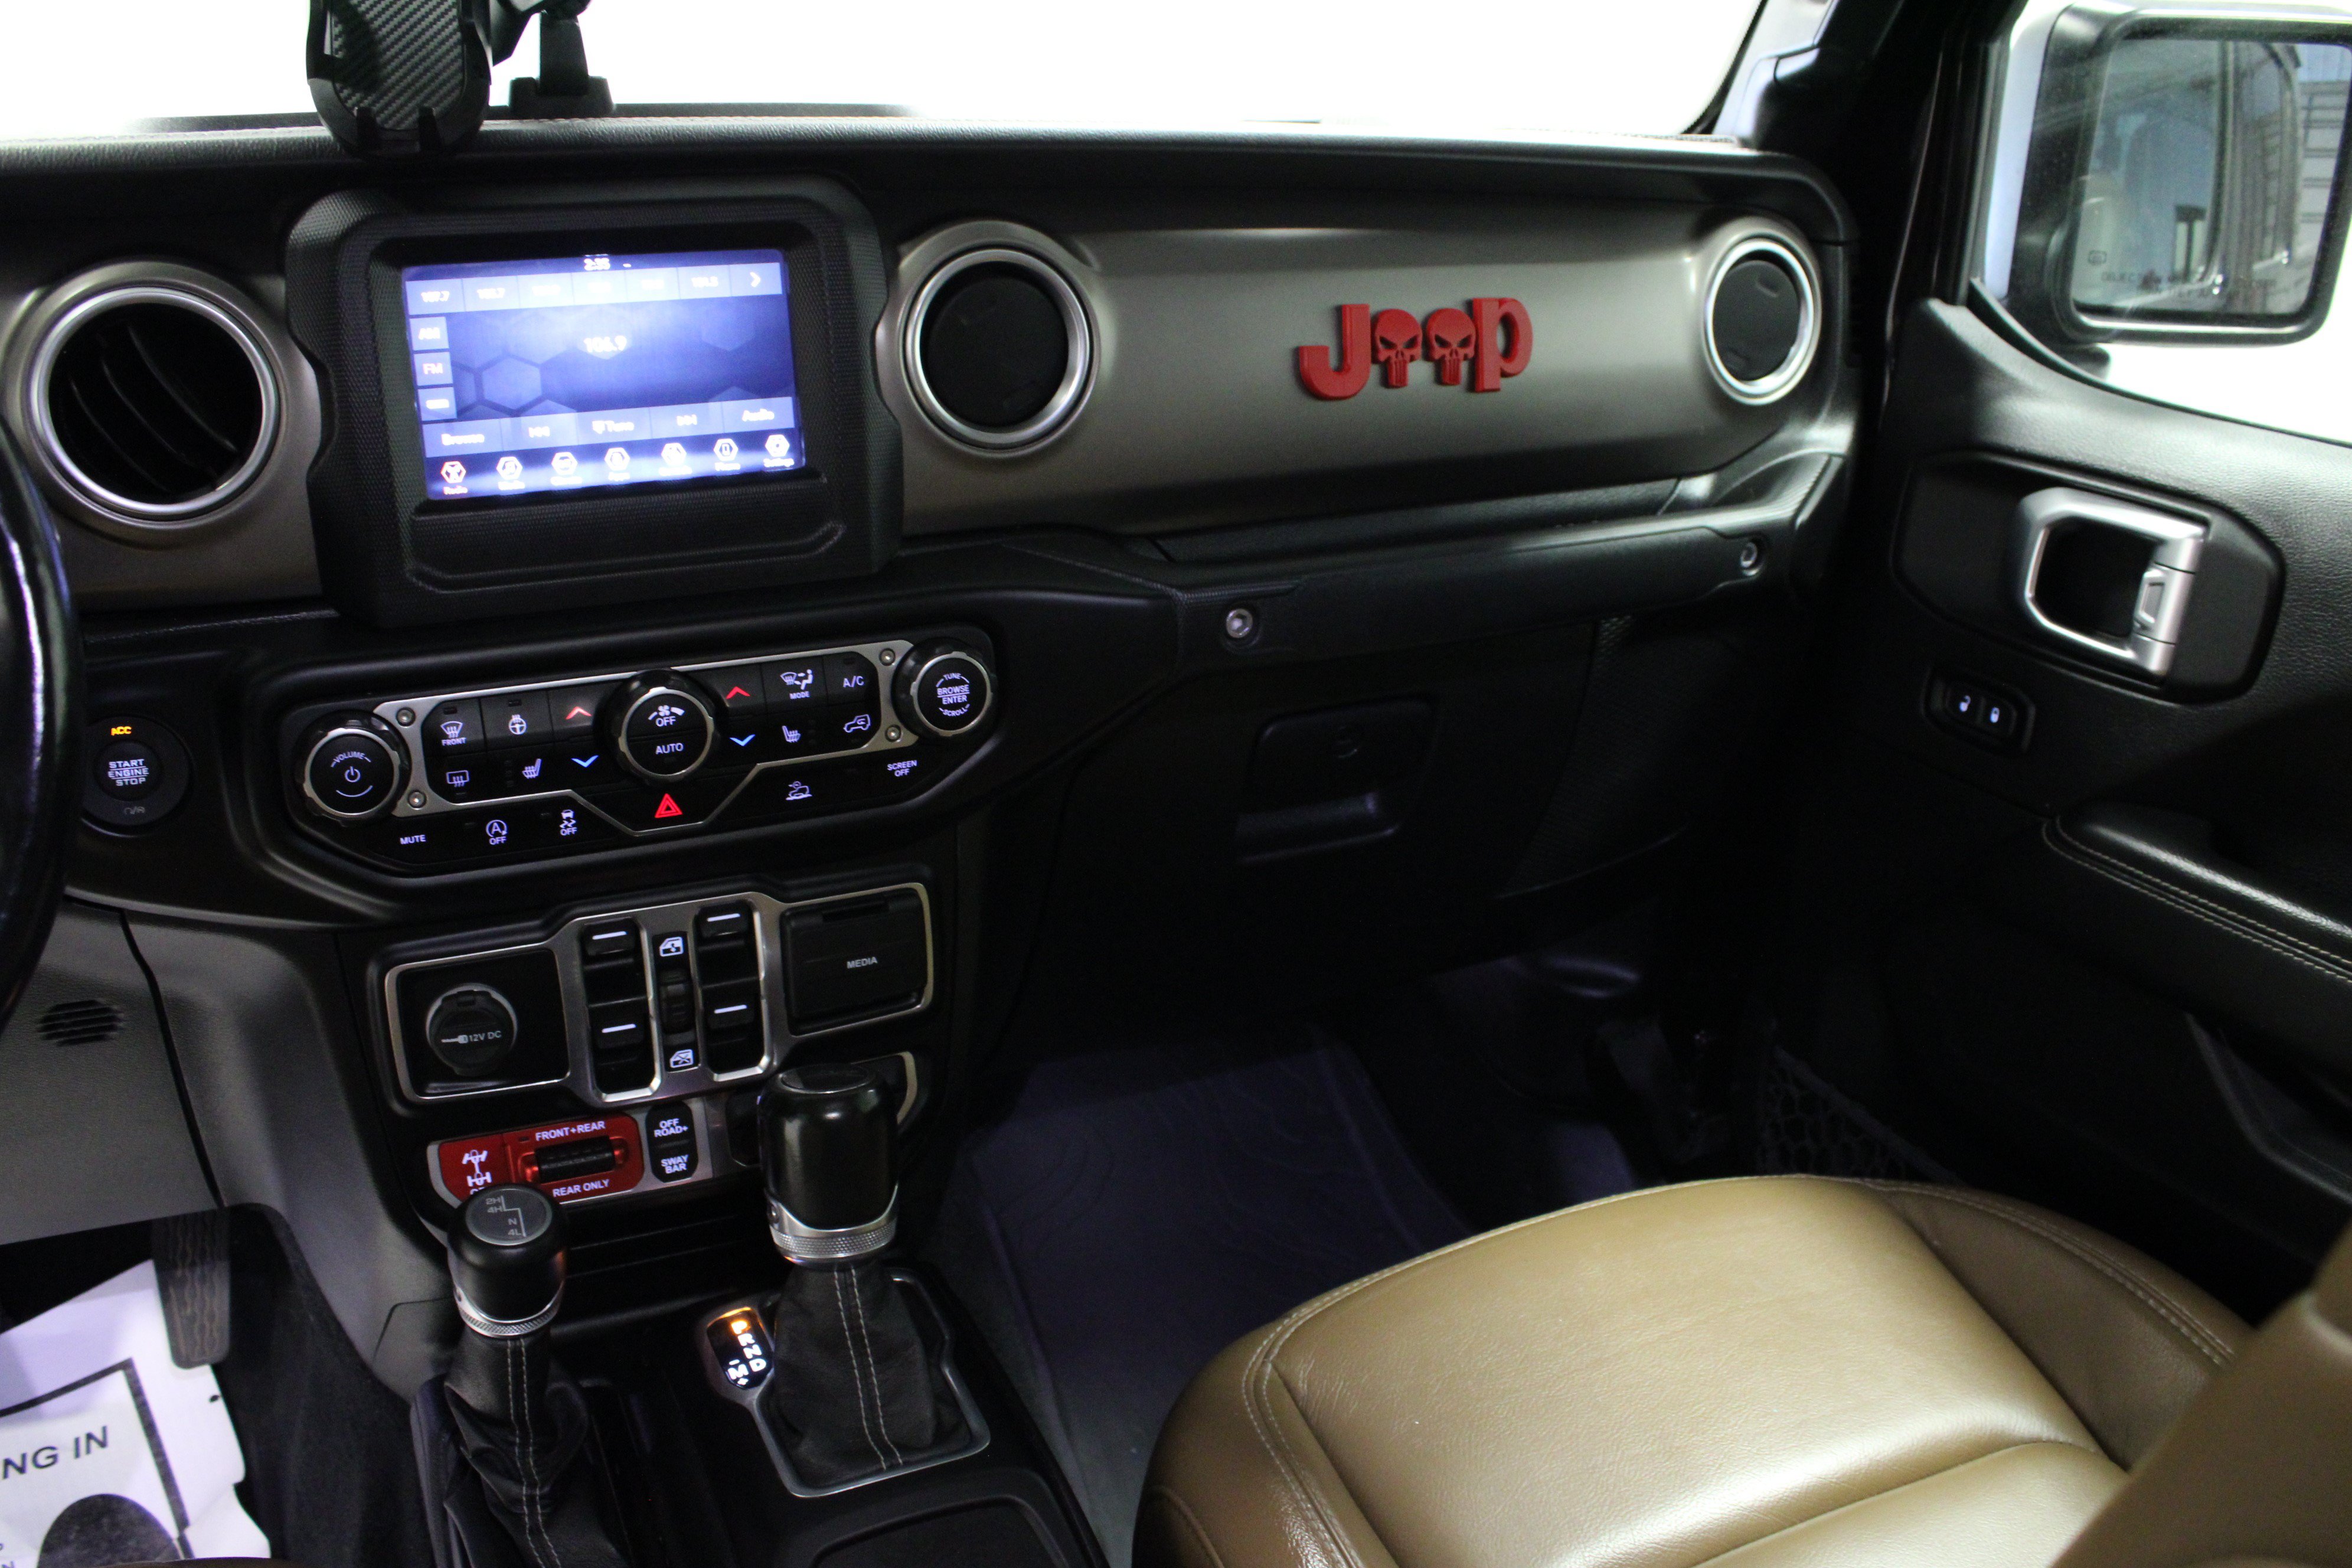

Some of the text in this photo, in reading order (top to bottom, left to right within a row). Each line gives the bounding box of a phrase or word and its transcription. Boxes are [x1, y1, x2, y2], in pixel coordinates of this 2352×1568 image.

[418, 327, 440, 340] AM
[423, 362, 443, 374] FM
[842, 675, 865, 688] A/C
[789, 691, 810, 700] MODE
[937, 684, 970, 695] BROWSE
[942, 695, 968, 704] ENTER
[943, 707, 968, 716] SCROLL
[655, 716, 677, 727] OFF
[110, 726, 132, 736] ACC
[441, 736, 467, 746] FRONT
[655, 742, 684, 754] AUTO
[333, 751, 365, 763] VOLUME
[109, 759, 145, 768] START
[887, 760, 918, 772] SCREEN
[107, 768, 149, 778] ENGINE
[894, 767, 910, 777] OFF
[116, 778, 146, 786] STOP
[560, 827, 577, 836] OFF
[400, 834, 426, 845] MUTE
[489, 836, 507, 845] OFF
[847, 956, 878, 968] MEDIA
[469, 1030, 502, 1042] 12V DC
[659, 1118, 680, 1129] OFF
[535, 1121, 606, 1141] FRONT+REAR
[654, 1125, 688, 1138] ROAD+
[661, 1154, 690, 1167] SWAY
[665, 1162, 688, 1174] BAR
[552, 1178, 610, 1197] REAR ONLY
[508, 1228, 522, 1236] 4L
[731, 1321, 748, 1334] P
[738, 1333, 755, 1347] R
[743, 1344, 762, 1359] N
[749, 1358, 766, 1372] D
[727, 1364, 749, 1380] M
[73, 1425, 109, 1460] IN
